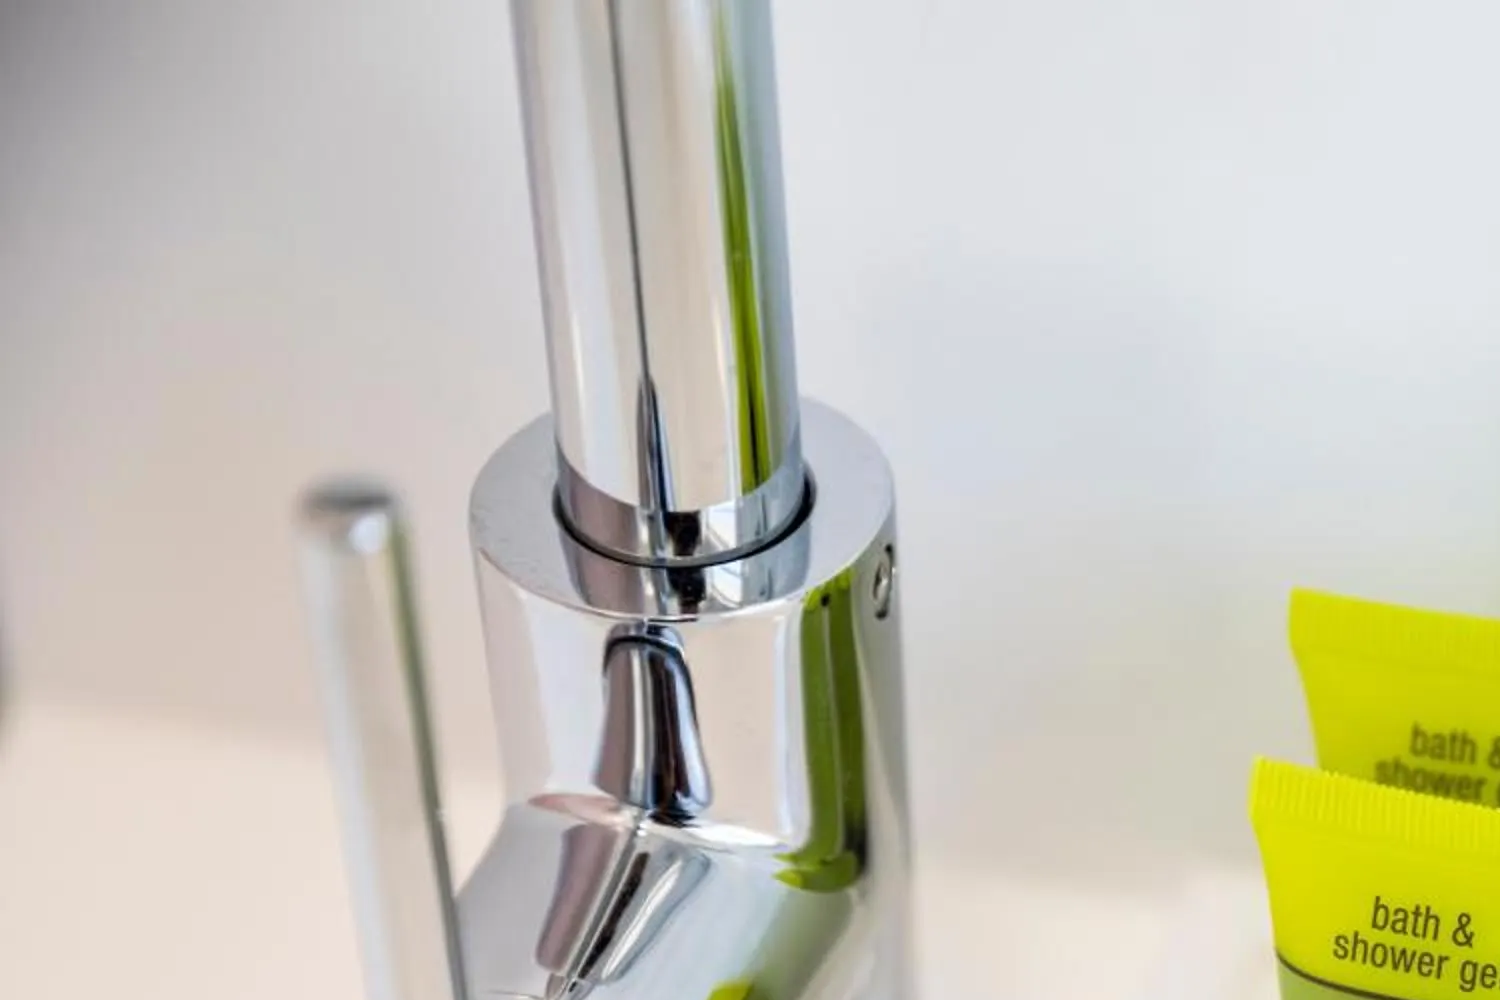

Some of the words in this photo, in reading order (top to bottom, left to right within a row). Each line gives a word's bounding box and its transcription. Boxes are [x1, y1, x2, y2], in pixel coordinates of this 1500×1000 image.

[1409, 721, 1477, 765] bath
[1374, 757, 1486, 801] shower
[1371, 895, 1441, 942] bath
[1451, 912, 1475, 948] &
[1332, 930, 1450, 980] shower
